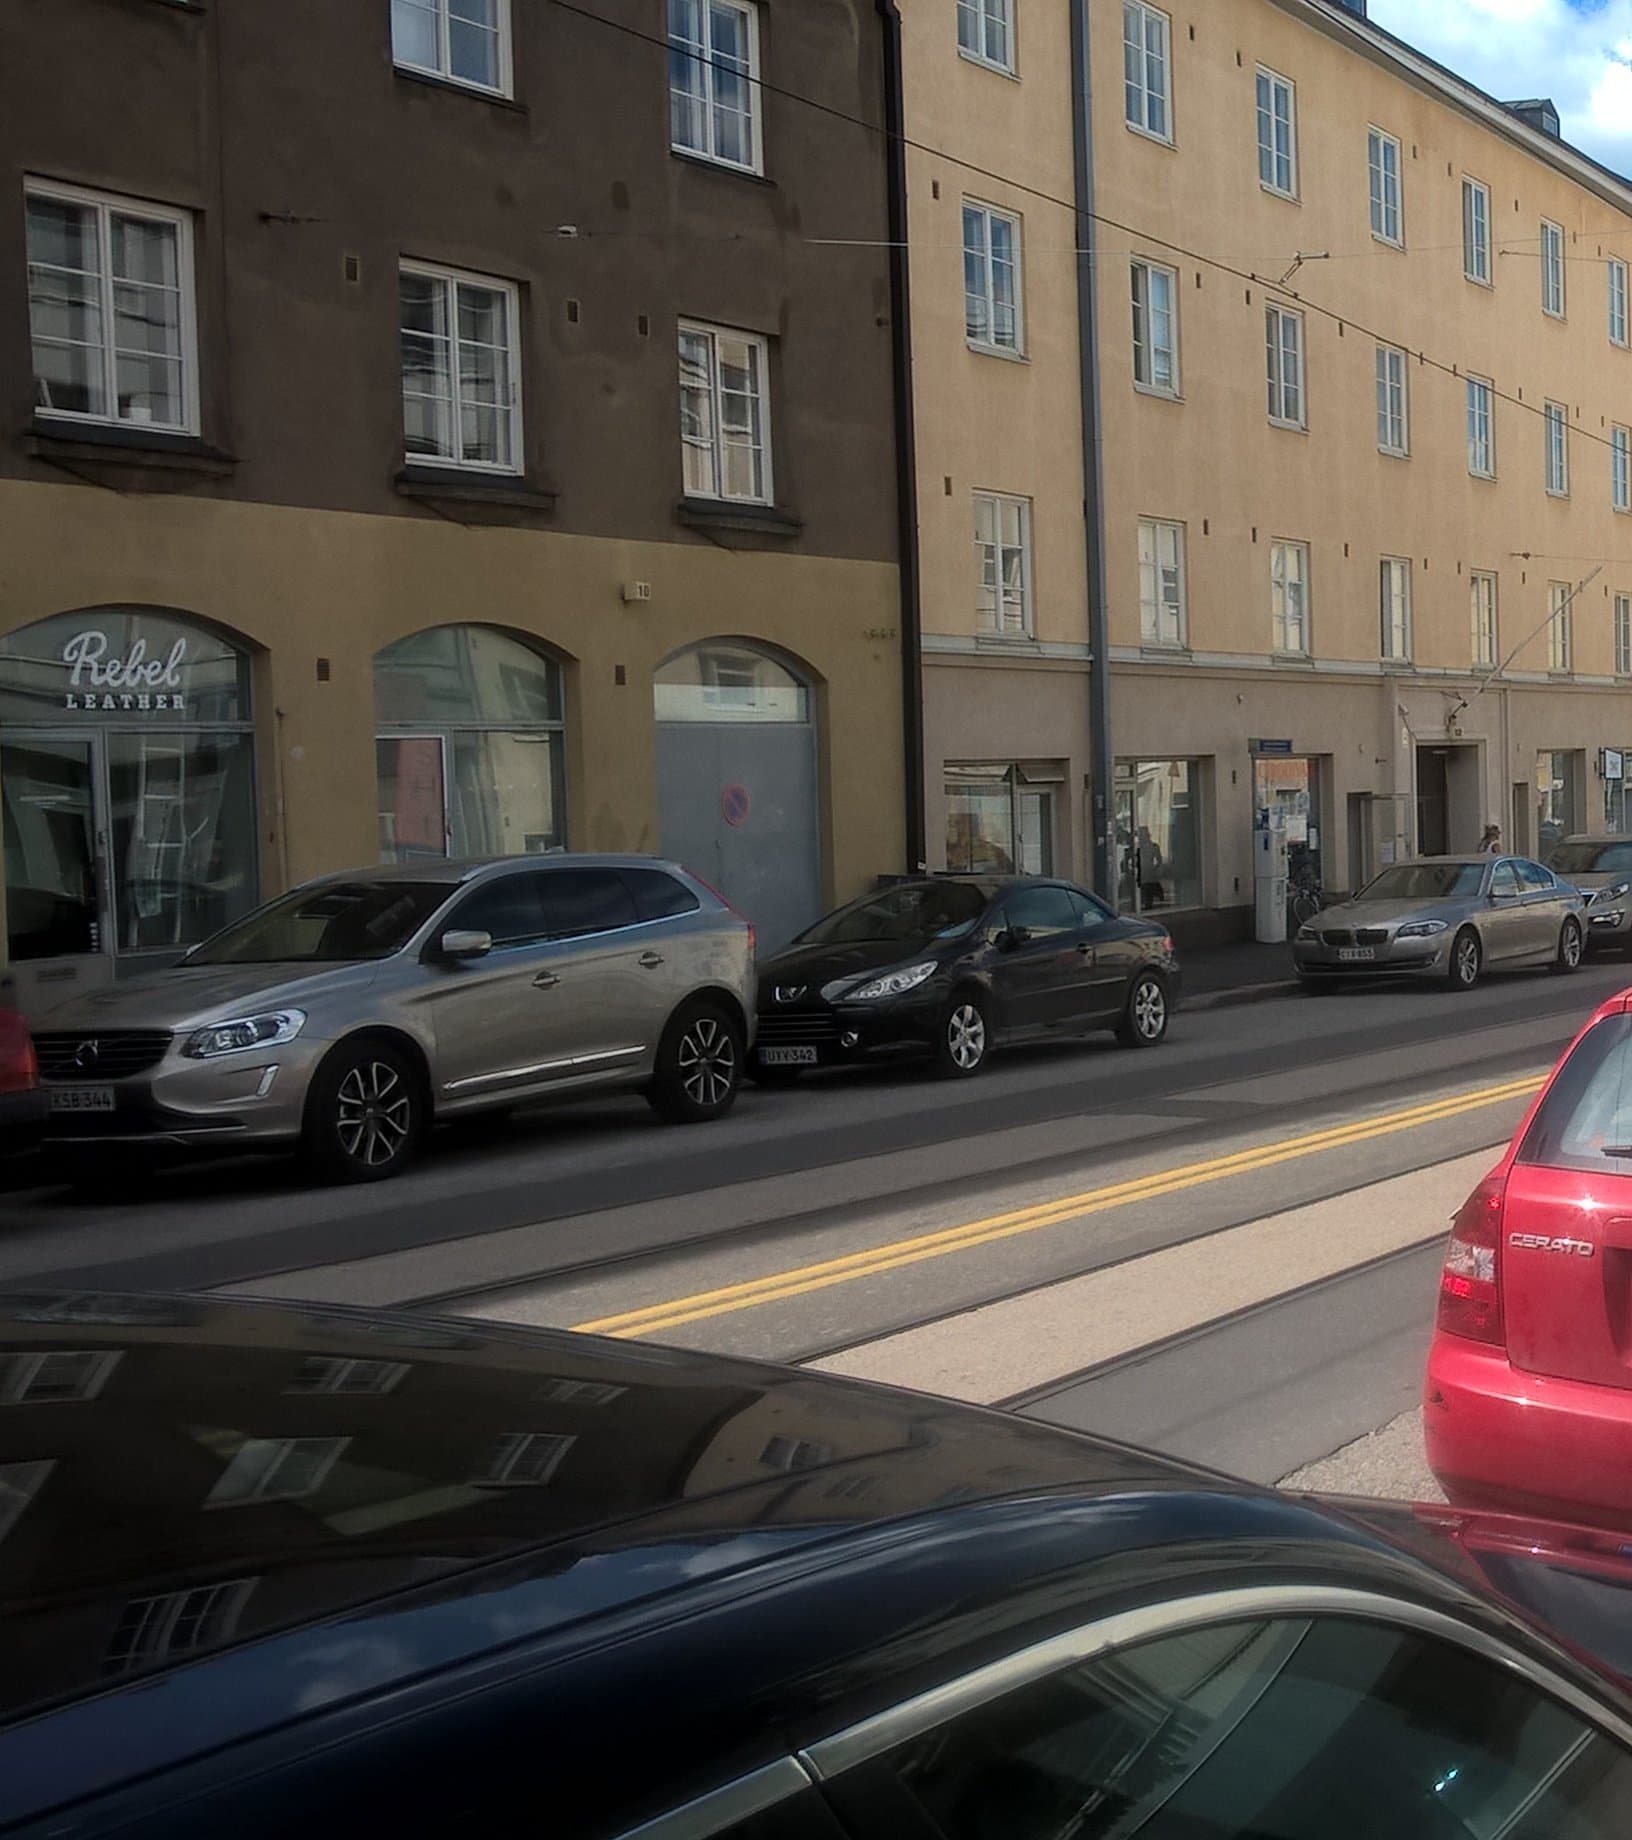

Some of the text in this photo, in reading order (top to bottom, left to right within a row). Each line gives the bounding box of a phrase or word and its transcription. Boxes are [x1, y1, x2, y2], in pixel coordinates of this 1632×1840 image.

[638, 584, 650, 598] 10
[63, 630, 187, 687] Rebel
[65, 693, 186, 710] LEATHER
[1509, 1232, 1594, 1256] CERATO
